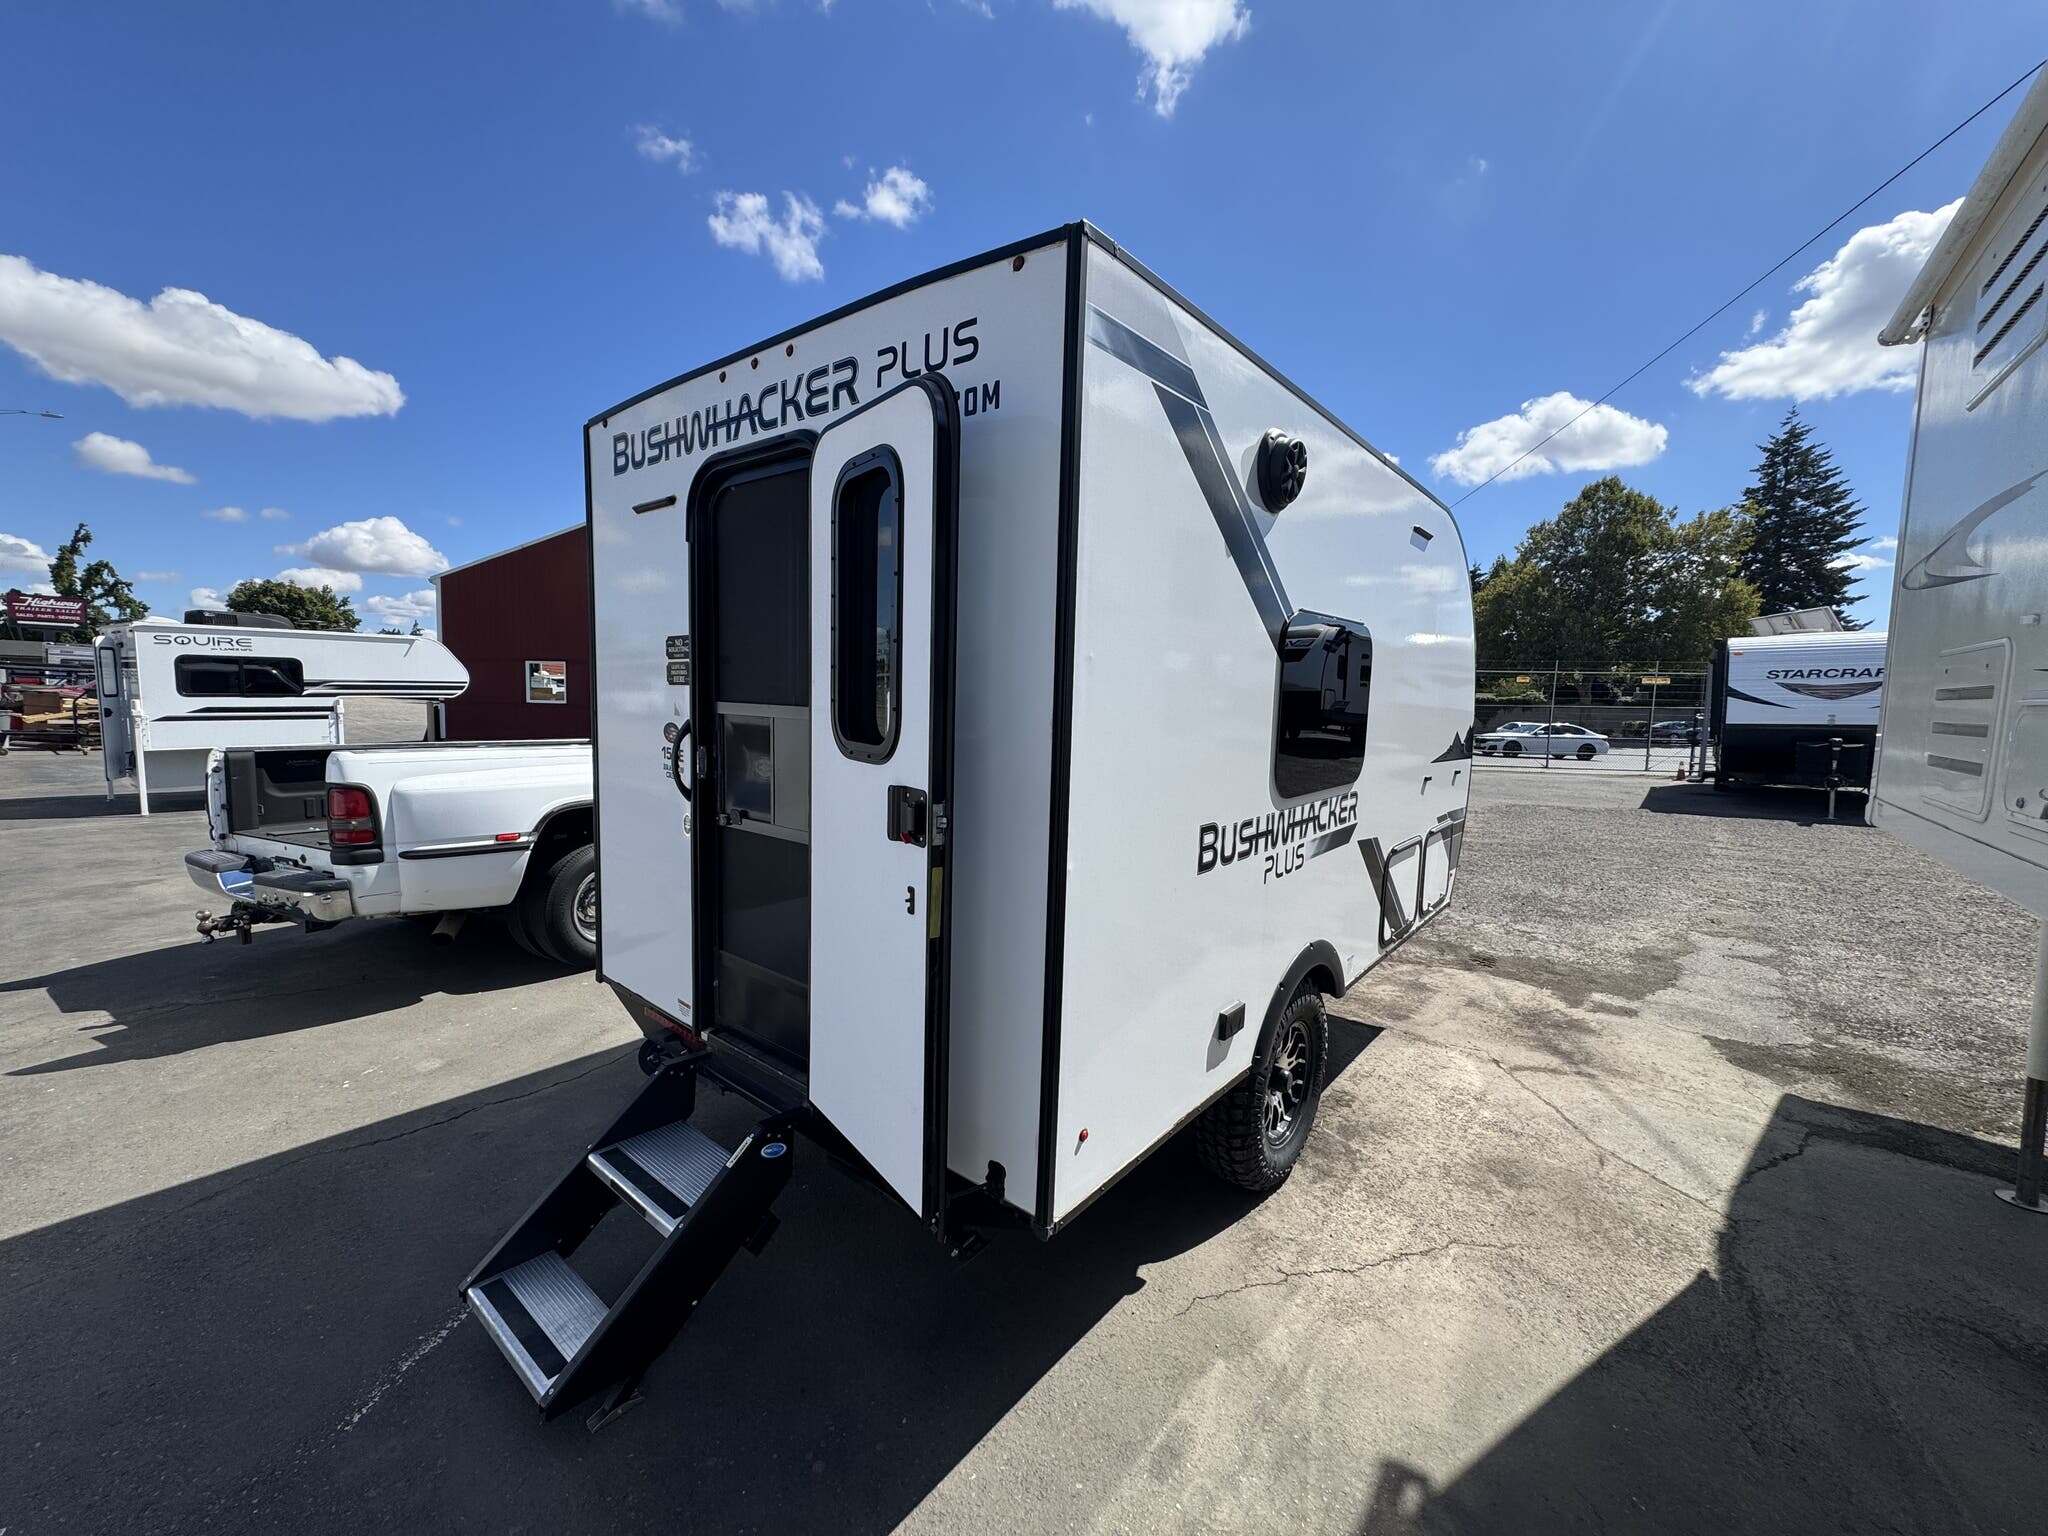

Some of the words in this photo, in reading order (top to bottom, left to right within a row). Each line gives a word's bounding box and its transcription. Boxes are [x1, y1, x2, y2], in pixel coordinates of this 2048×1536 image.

[613, 356, 860, 477] BUSHWHACKER
[877, 317, 979, 388] PLUS
[955, 380, 1001, 417] OM
[12, 596, 82, 610] Highway
[153, 634, 253, 648] SQUIRE
[674, 638, 683, 647] NO
[1766, 667, 1884, 679] STARCRAF
[1197, 791, 1359, 876] BUSHWHACKER
[1263, 843, 1305, 885] PLUS
